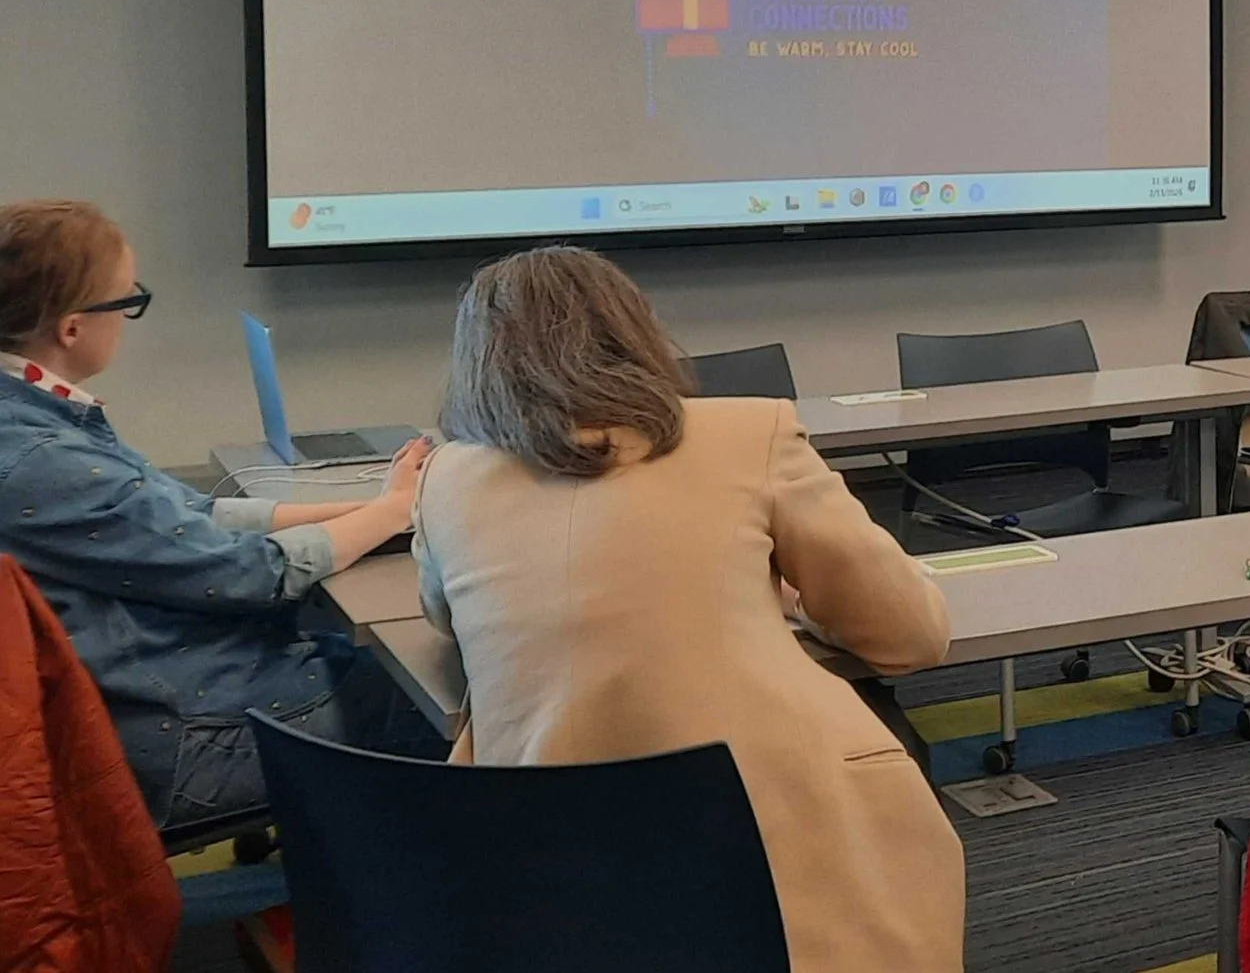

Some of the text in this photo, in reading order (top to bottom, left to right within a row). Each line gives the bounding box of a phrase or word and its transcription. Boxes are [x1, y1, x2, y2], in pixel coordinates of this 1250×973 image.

[750, 3, 909, 32] CONNECTIONS
[747, 39, 919, 59] BE WARM, STAY COOL
